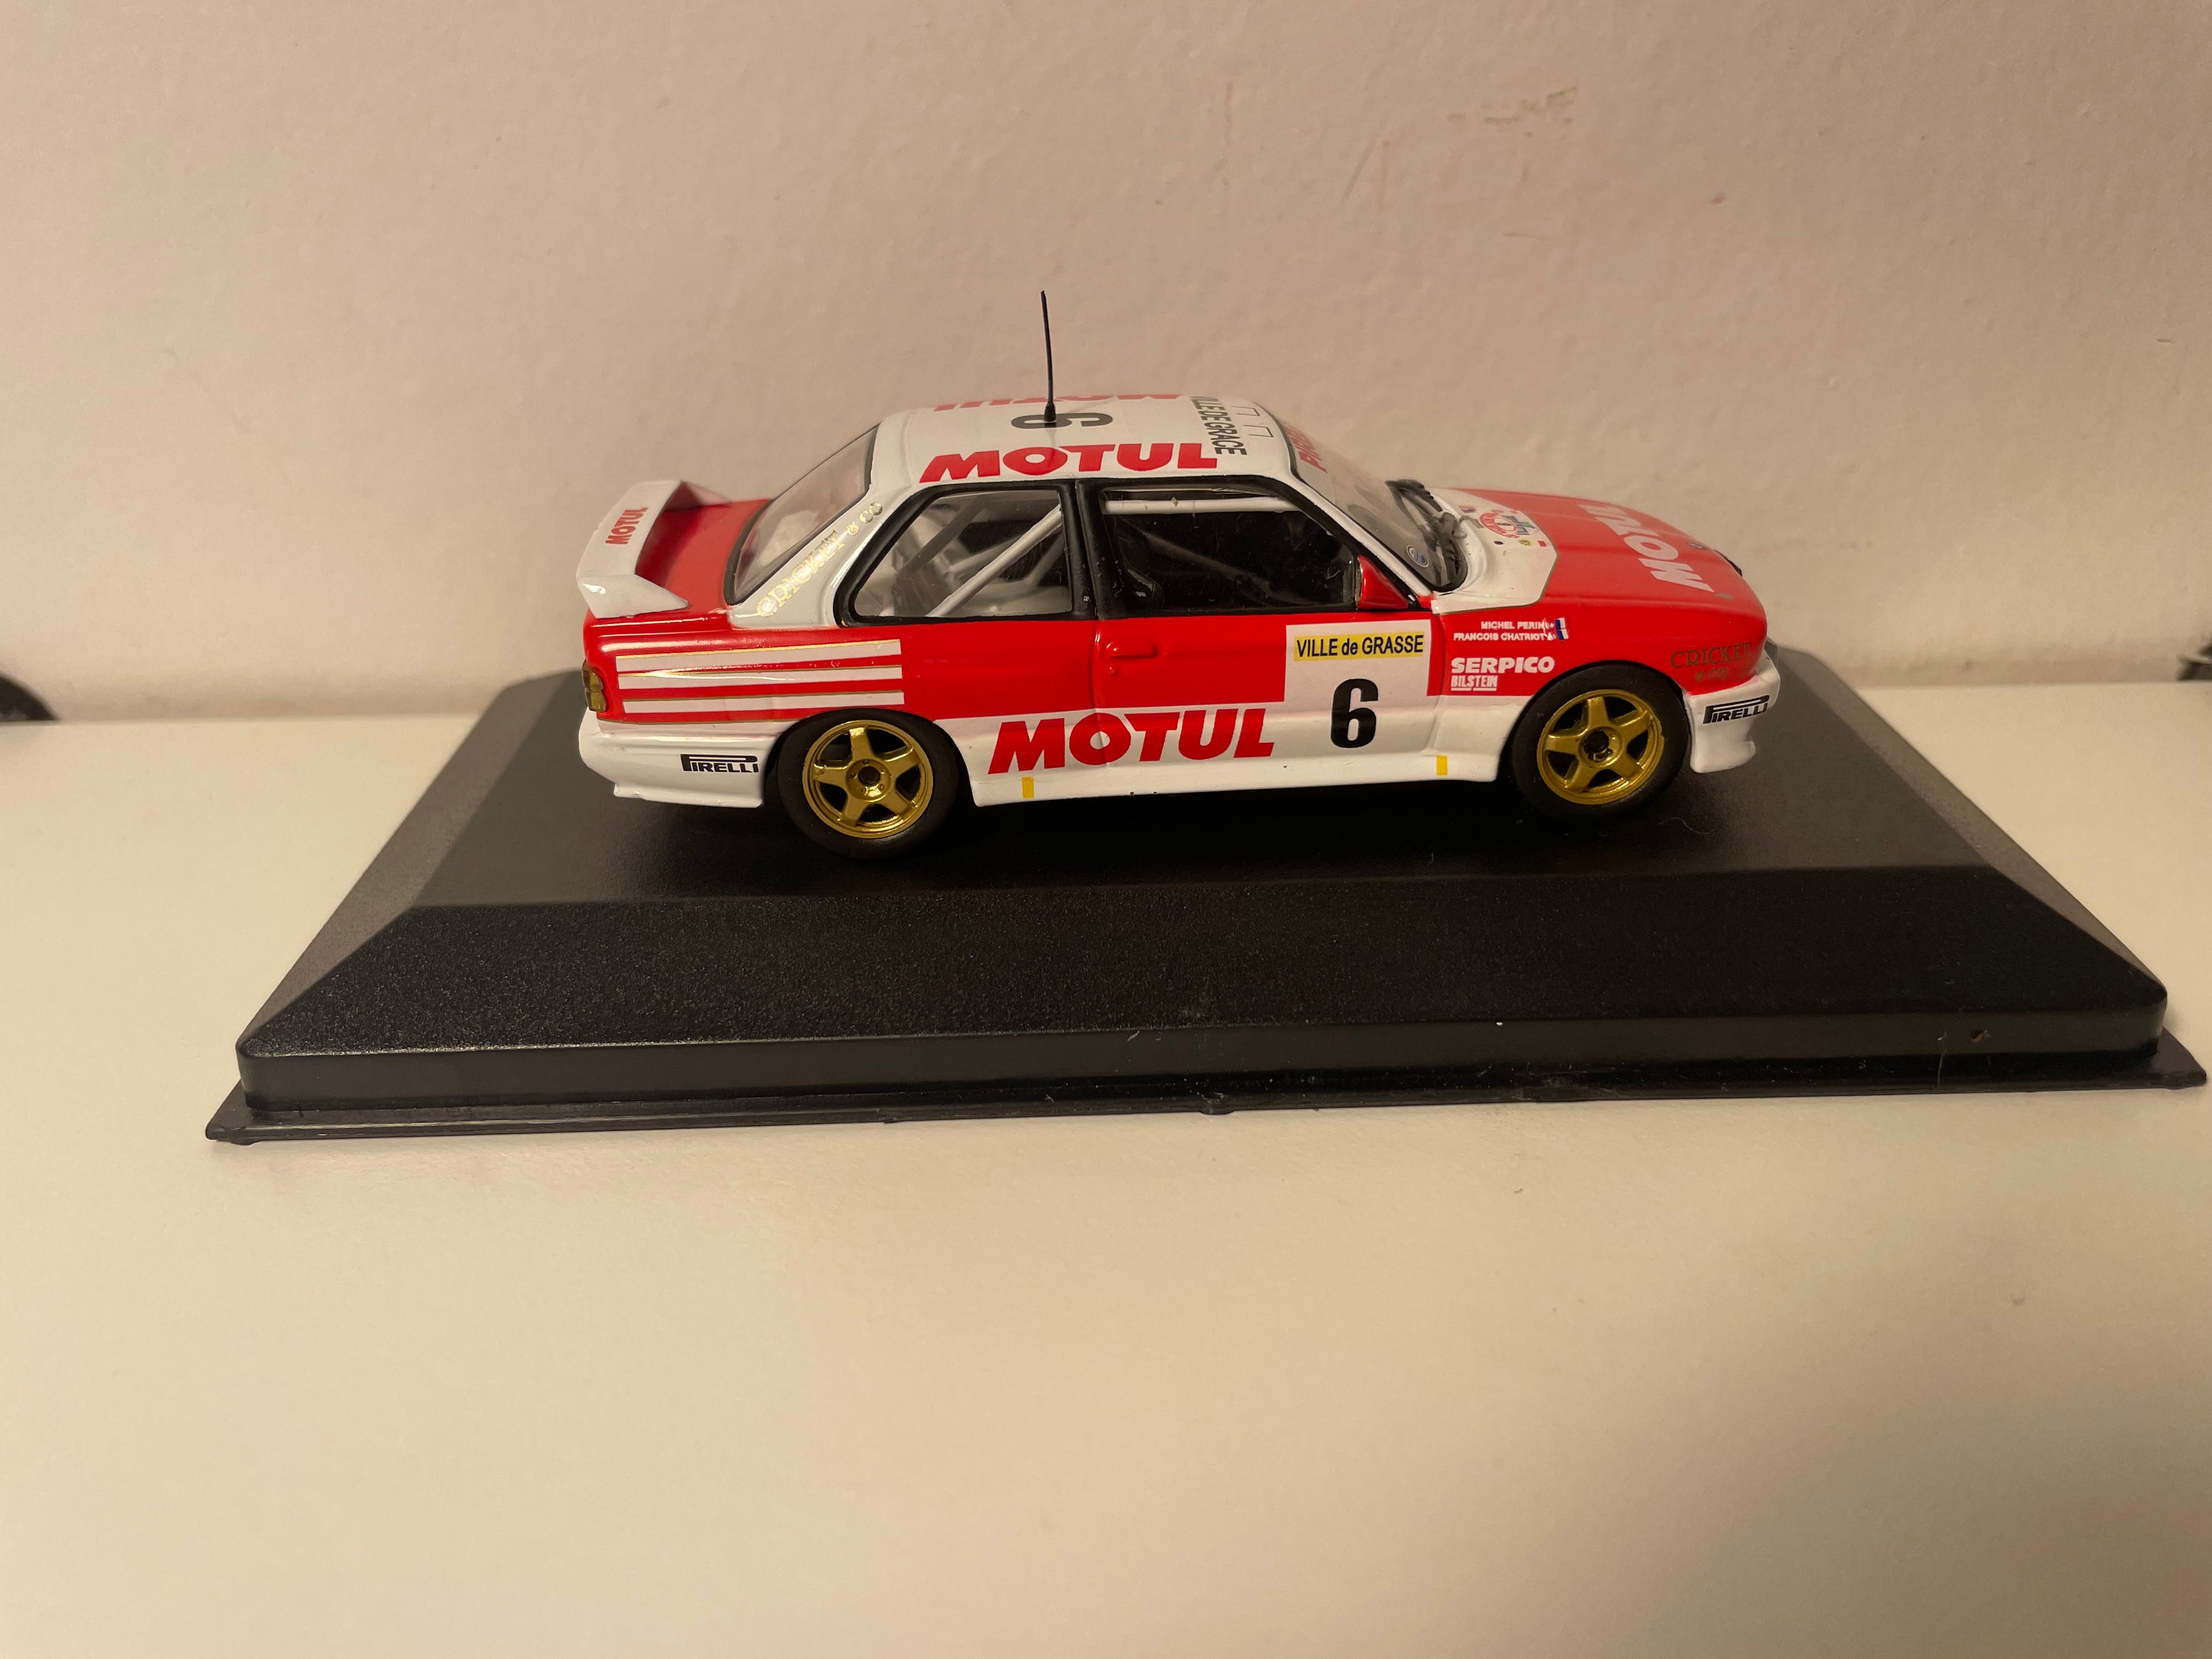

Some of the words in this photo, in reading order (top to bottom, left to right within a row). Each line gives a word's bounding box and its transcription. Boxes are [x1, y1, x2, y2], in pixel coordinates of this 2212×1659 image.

[1203, 422, 1248, 456] GRACE
[919, 442, 1217, 483] MOTUL
[605, 507, 649, 545] MOTUL
[756, 530, 845, 617] CRICKET
[1480, 621, 1514, 630] MICHEL
[1501, 632, 1544, 641] CHATRIOT
[1297, 638, 1338, 657] VILLE
[1342, 638, 1358, 656] de
[1362, 635, 1424, 654] GRASSE
[1670, 642, 1751, 668] CRICKET
[1451, 656, 1555, 673] SERPICO
[1450, 675, 1498, 687] BILSTEIN
[1330, 679, 1378, 748] 6
[1703, 695, 1770, 725] PIRELLI
[988, 708, 1275, 775] MOTUL
[680, 754, 759, 772] PIRELLI
